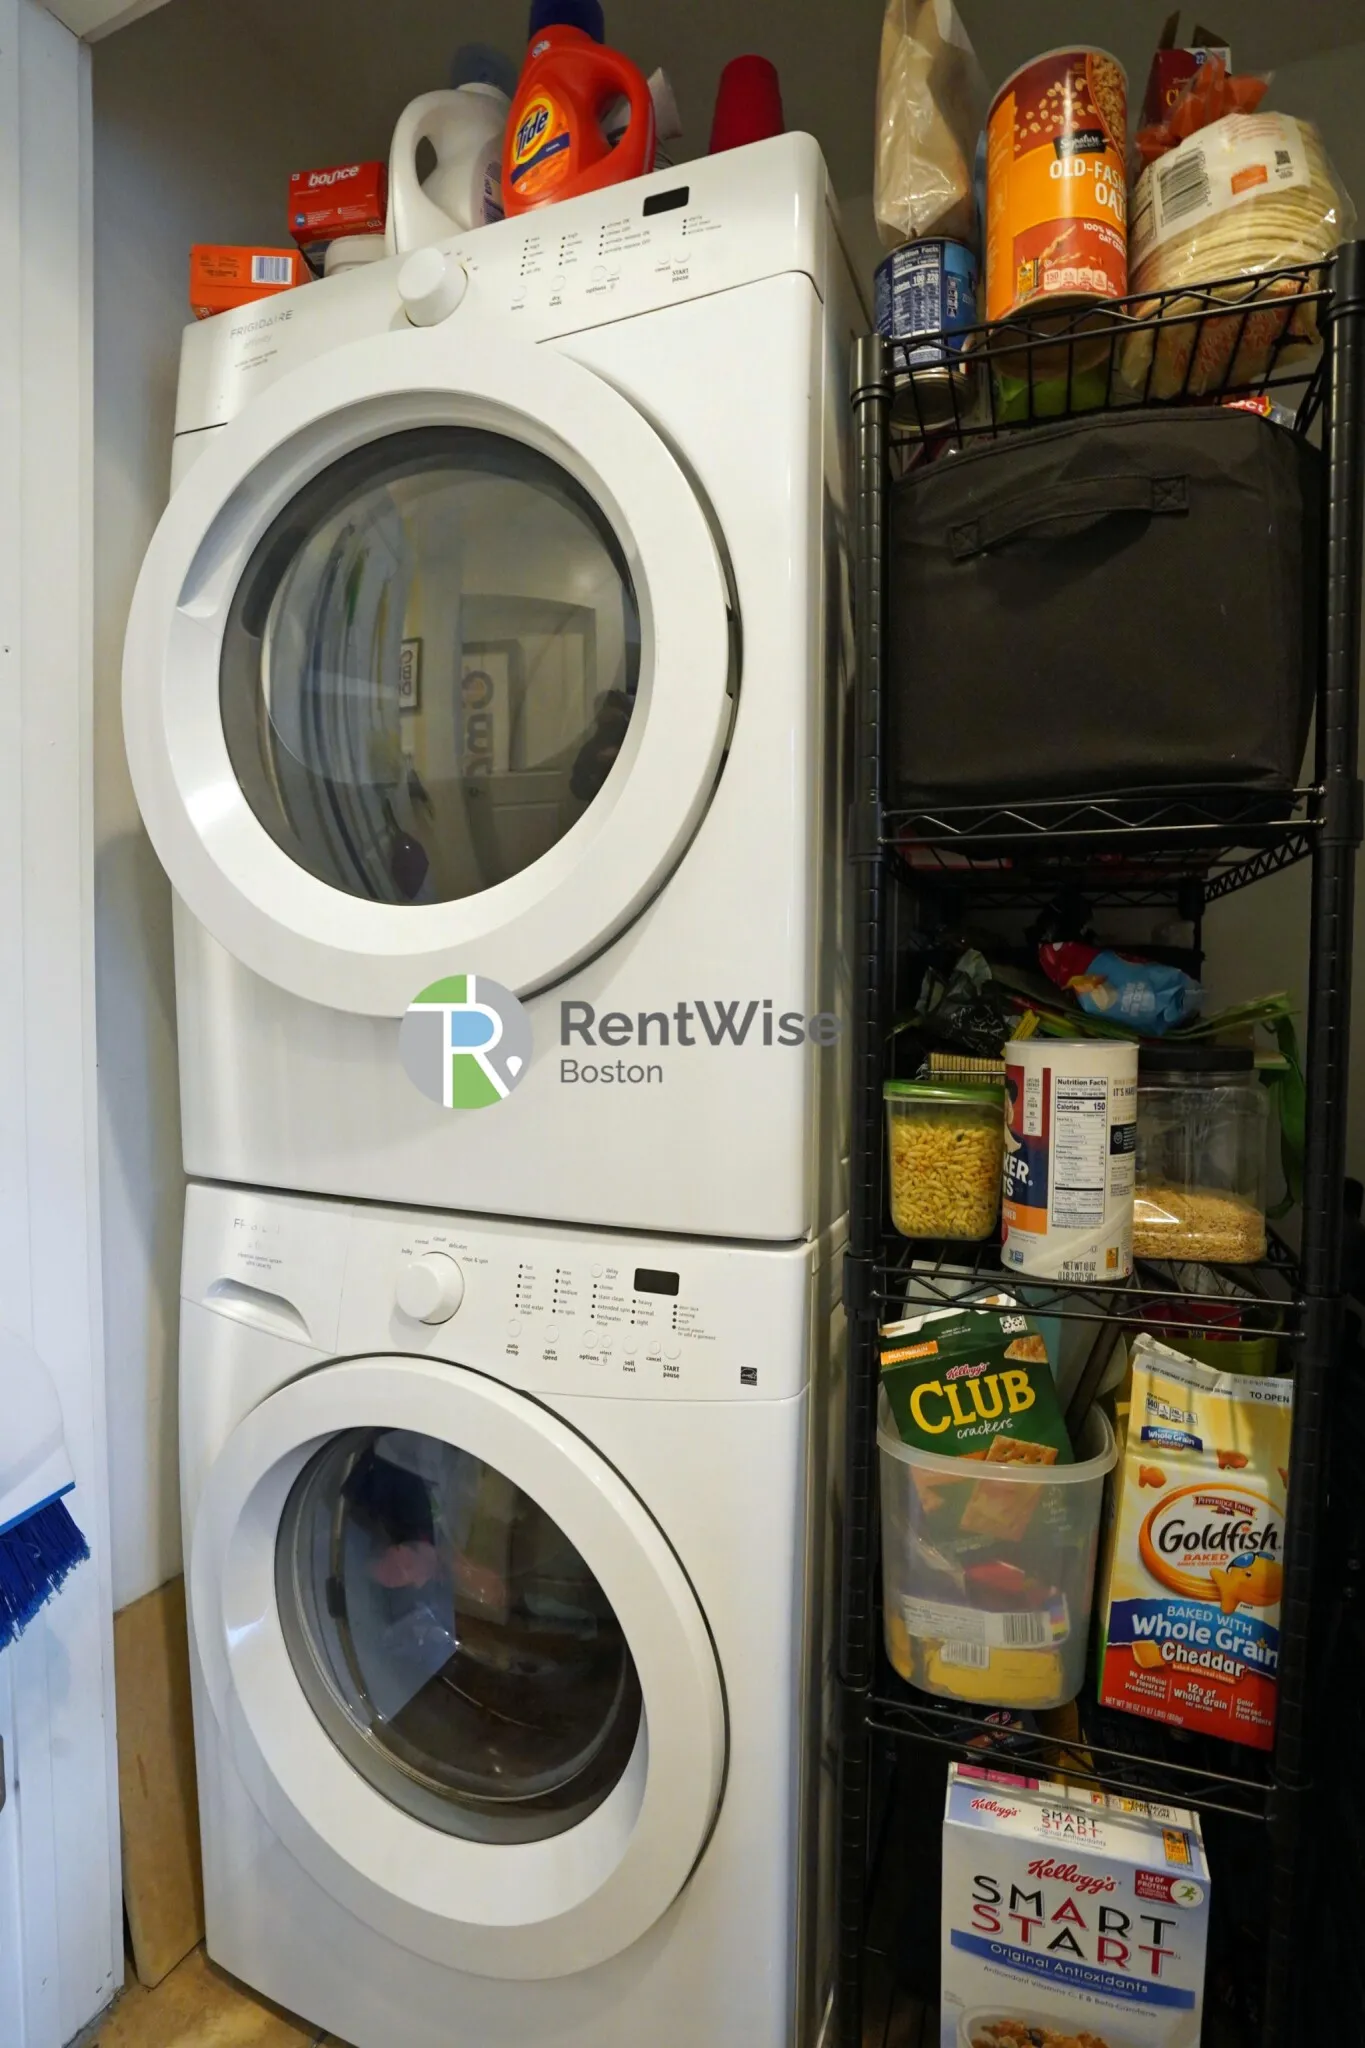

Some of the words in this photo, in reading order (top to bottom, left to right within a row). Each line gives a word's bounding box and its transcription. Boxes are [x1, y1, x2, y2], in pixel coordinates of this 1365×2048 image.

[517, 108, 549, 160] Tide
[308, 165, 360, 187] bounce
[672, 268, 689, 276] START
[229, 308, 294, 339] FRIGIDAIRE
[1056, 1103, 1080, 1111] Calories
[1094, 1102, 1106, 1110] 150
[1063, 1261, 1073, 1271] NET
[1074, 1261, 1083, 1271] WT
[506, 1348, 519, 1356] temp
[579, 1353, 599, 1361] options
[946, 1363, 987, 1380] Kellogg's
[910, 1370, 1036, 1434] CLUB
[1249, 1391, 1262, 1400] TO
[1264, 1392, 1290, 1403] OPEN
[957, 1417, 1014, 1439] crackers
[1148, 1430, 1172, 1440] Whole
[1173, 1433, 1195, 1446] Grain
[1197, 1496, 1234, 1508] PEPPERIDGE
[1234, 1502, 1252, 1515] FARM
[1159, 1519, 1278, 1553] Goldfish
[1183, 1553, 1229, 1561] BAKED
[1167, 1605, 1213, 1622] BAKED
[1217, 1615, 1253, 1636] WITH
[1132, 1613, 1211, 1645] Whole
[1216, 1628, 1278, 1668] Grain
[1161, 1641, 1245, 1677] Cheddar
[1136, 1679, 1158, 1691] Flavors
[1139, 1672, 1167, 1686] Artificial
[1125, 1682, 1165, 1699] Preservatives
[1174, 1687, 1200, 1701] Whole
[1203, 1695, 1228, 1710] Grain
[1187, 1682, 1203, 1697] 12g
[1205, 1688, 1216, 1698] of
[1105, 1695, 1116, 1705] NET
[1116, 1698, 1126, 1708] WT
[1235, 1712, 1250, 1721] from
[1251, 1715, 1272, 1727] Plants
[971, 1797, 1018, 1818] Kellogg's
[1042, 1808, 1101, 1828] SMART
[1042, 1816, 1100, 1838] START
[1028, 1858, 1118, 1894] Kellogg's
[1137, 1880, 1169, 1891] PROTEIN
[1154, 1876, 1165, 1884] OF
[972, 1875, 1177, 1945] SMART
[971, 1904, 1176, 1977] START
[991, 1943, 1049, 1970] Original
[1054, 1960, 1148, 1994] Antioxidants
[983, 1965, 1029, 1986] Antioxidant
[1031, 1978, 1066, 1997] Vitamins
